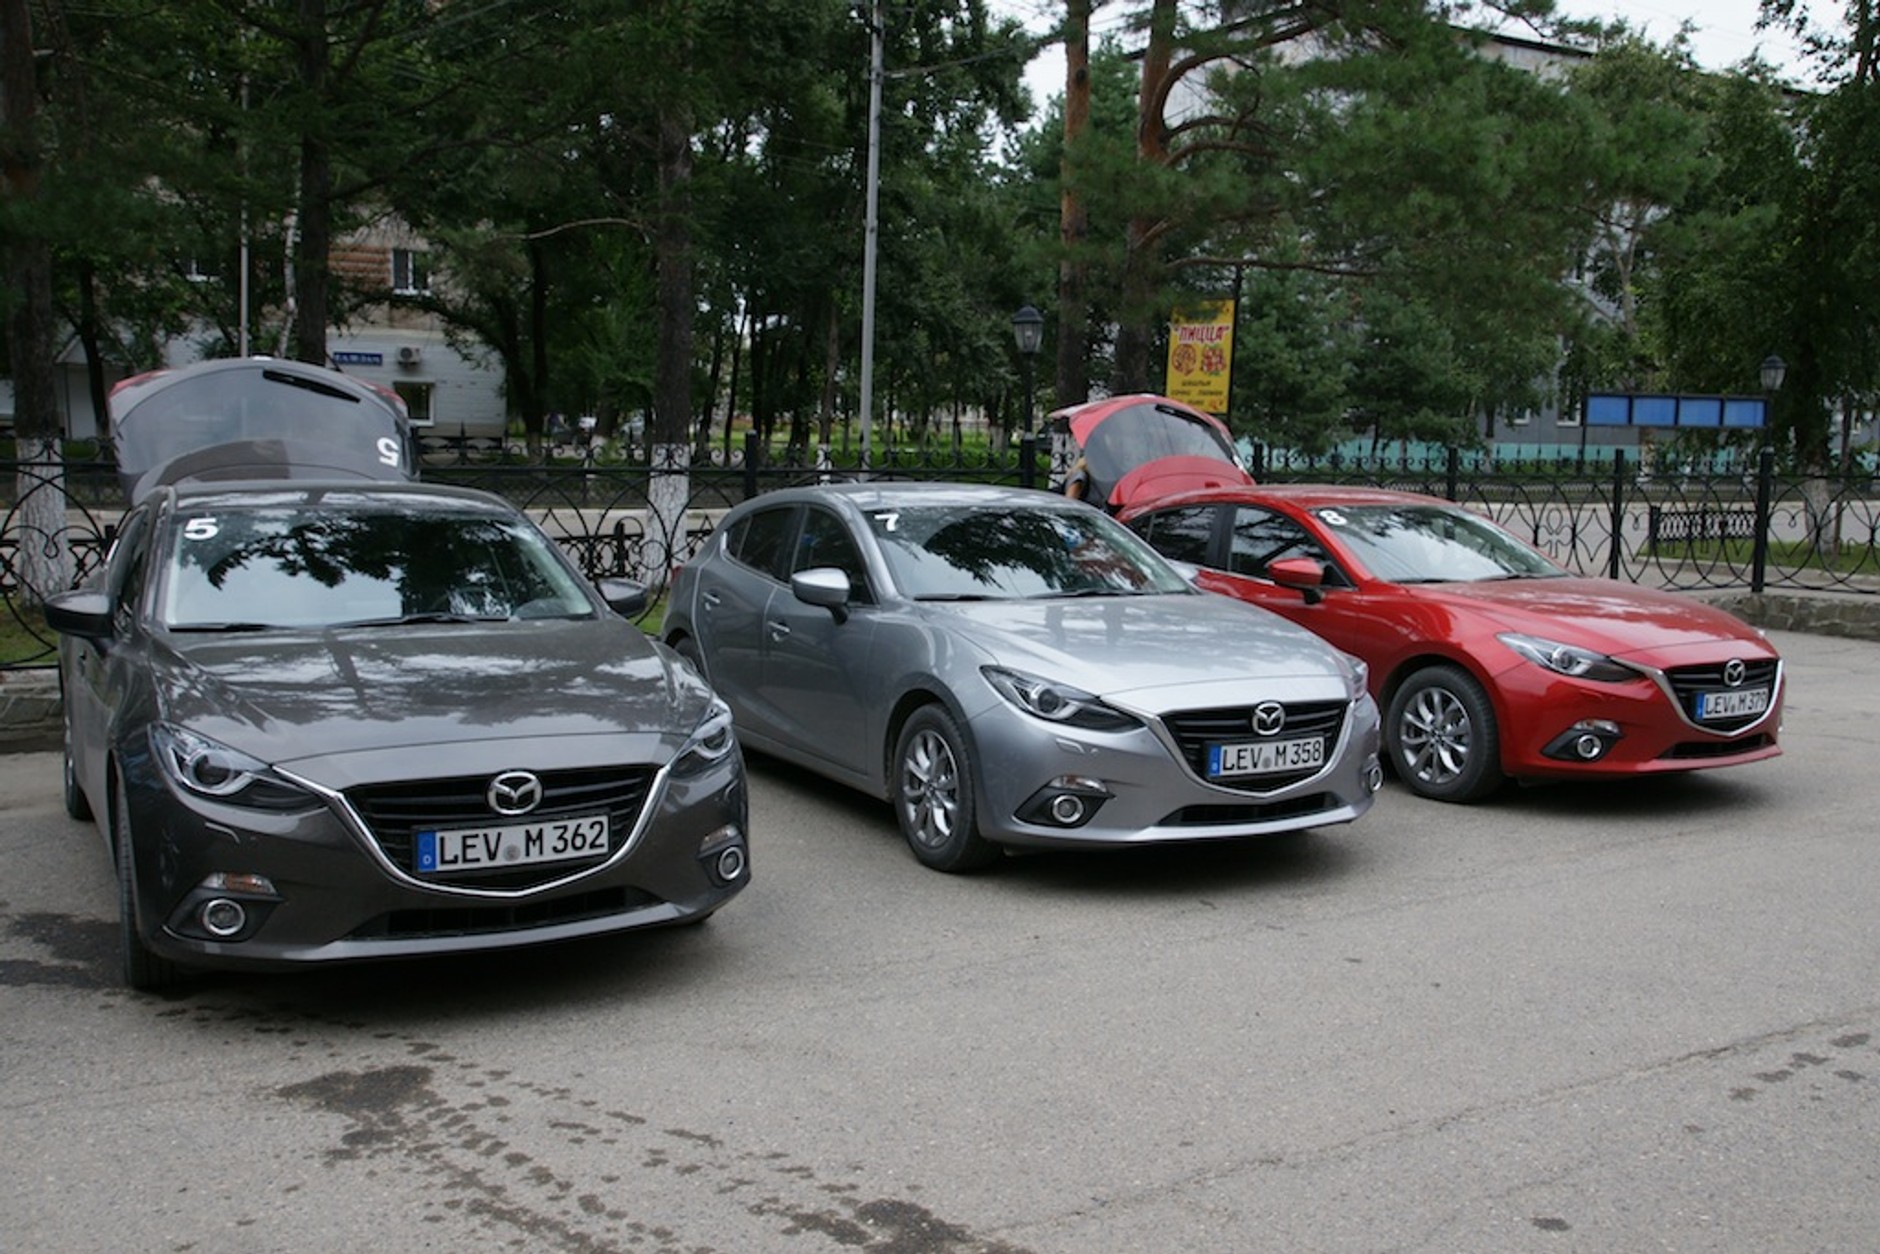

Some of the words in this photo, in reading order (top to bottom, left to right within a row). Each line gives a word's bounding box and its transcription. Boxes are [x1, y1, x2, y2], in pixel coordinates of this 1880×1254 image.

[377, 437, 399, 467] 5
[184, 517, 218, 540] 5
[874, 513, 899, 532] 7
[1319, 510, 1347, 525] 8
[1705, 695, 1732, 715] LEV
[1222, 747, 1263, 771] LEV
[1274, 744, 1287, 767] M
[1290, 740, 1322, 765] 358
[439, 832, 502, 866] LEV
[525, 827, 544, 857] M
[552, 820, 606, 854] 362
